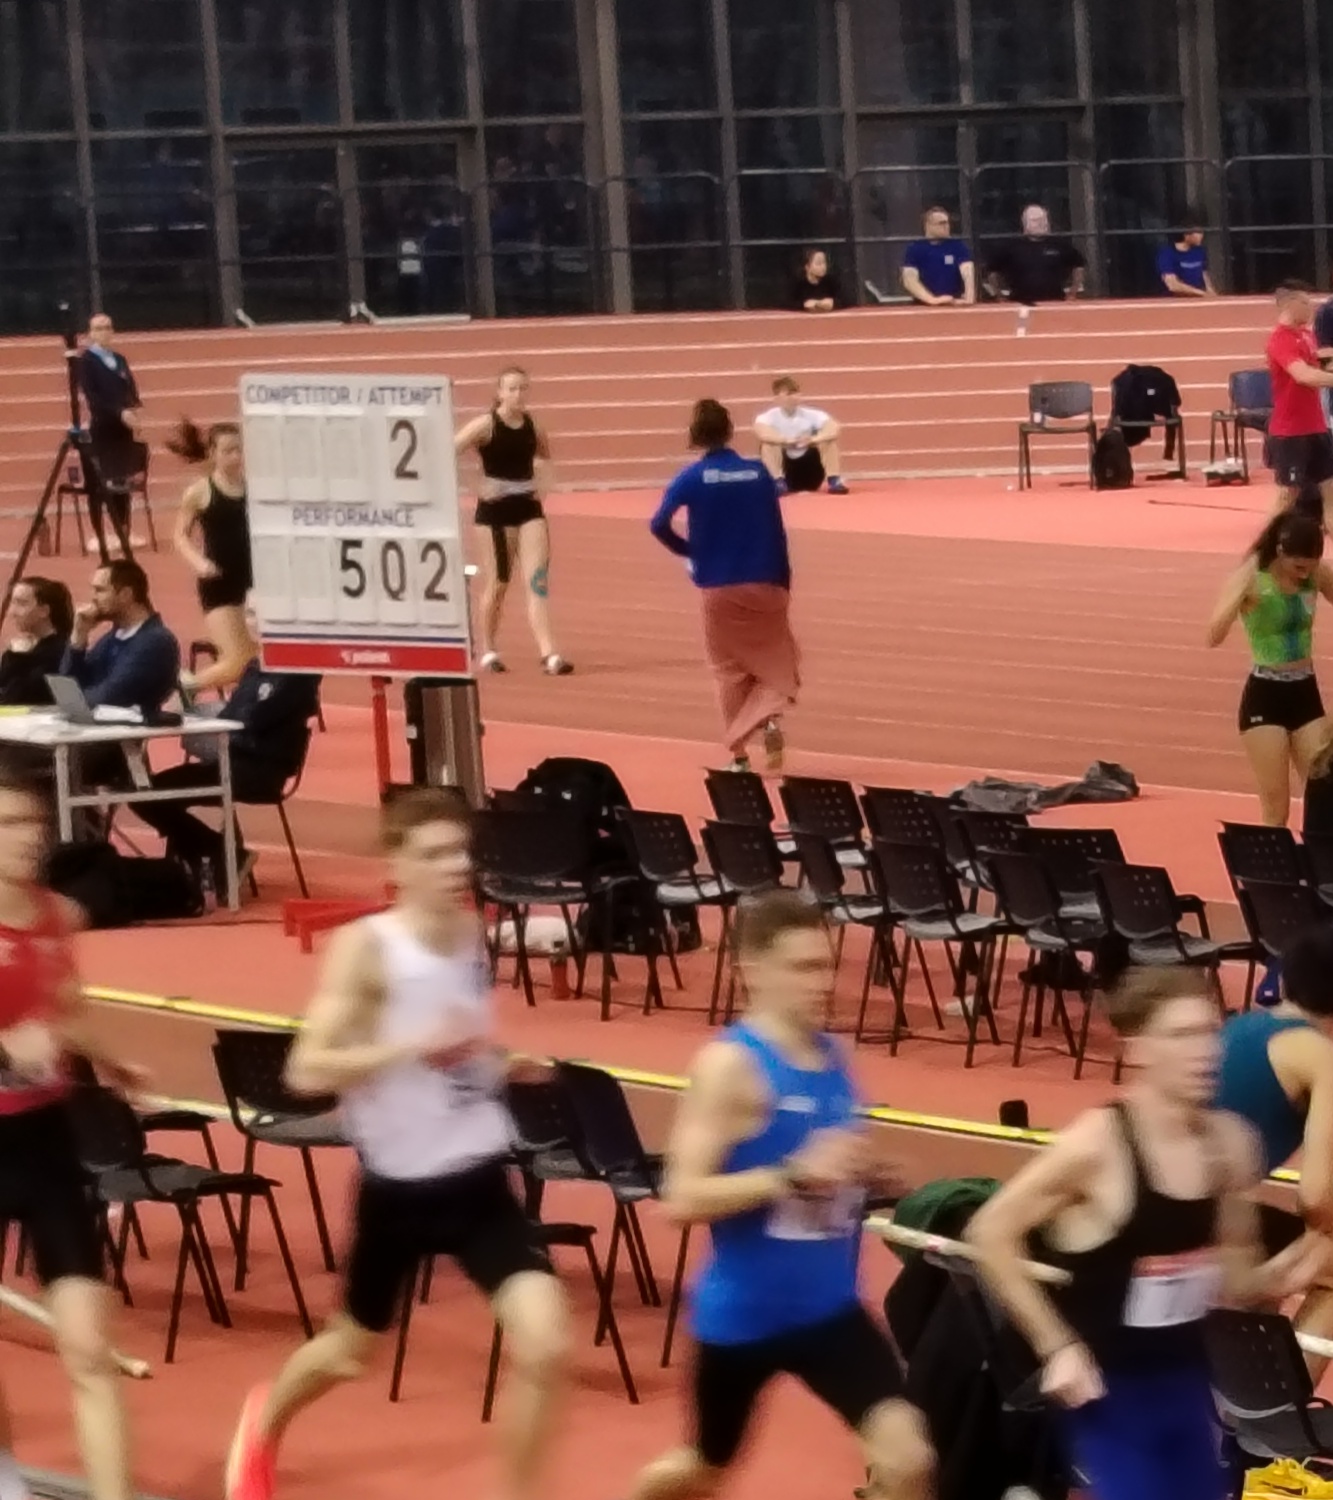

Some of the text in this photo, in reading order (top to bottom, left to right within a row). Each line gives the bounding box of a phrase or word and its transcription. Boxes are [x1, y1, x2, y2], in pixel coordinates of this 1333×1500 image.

[246, 384, 353, 405] COMPETITOR
[367, 385, 443, 405] ATTEMPT
[390, 419, 419, 480] 2
[292, 509, 415, 528] PERFORMANCE
